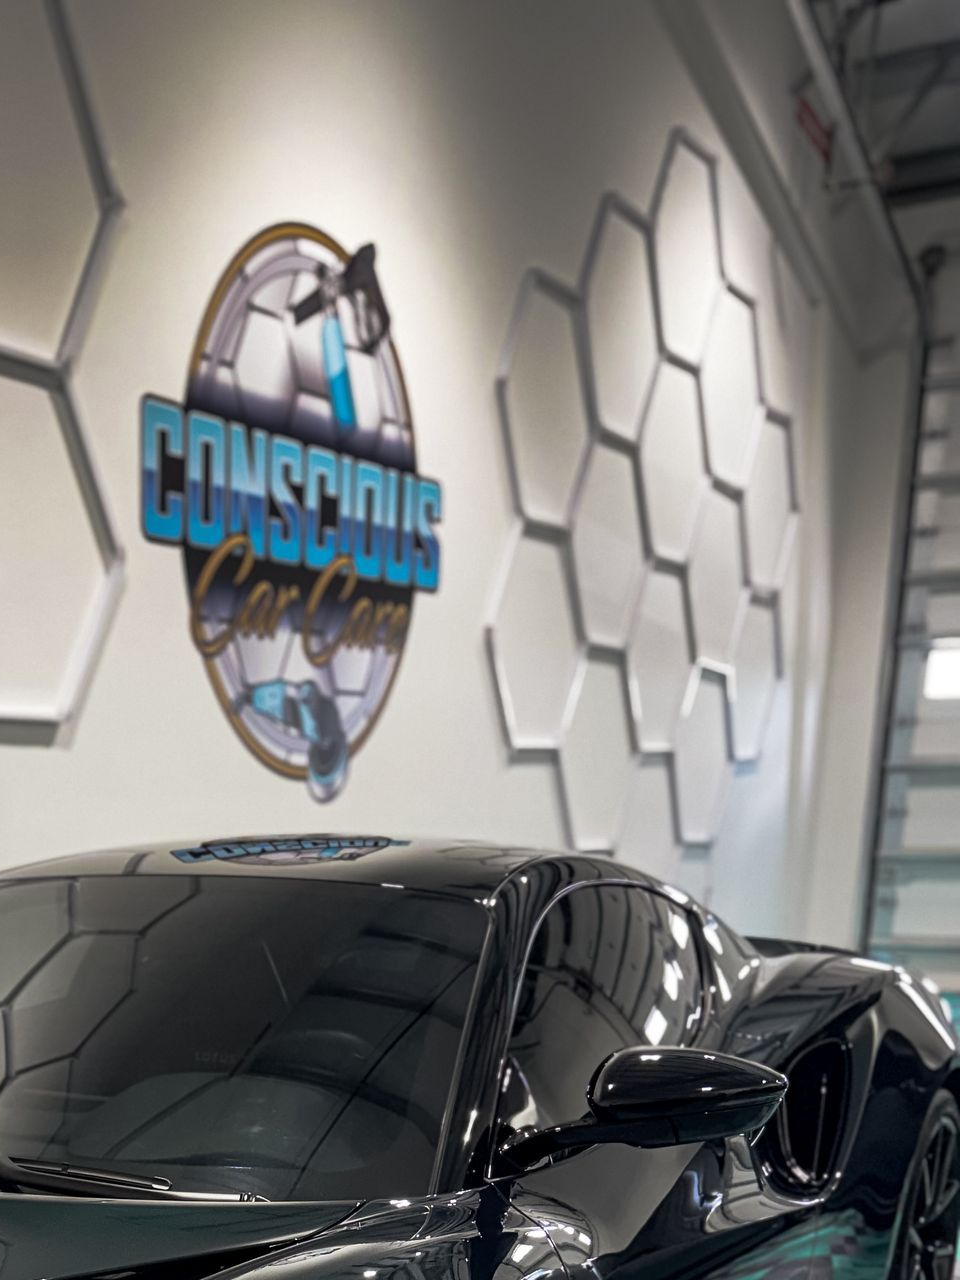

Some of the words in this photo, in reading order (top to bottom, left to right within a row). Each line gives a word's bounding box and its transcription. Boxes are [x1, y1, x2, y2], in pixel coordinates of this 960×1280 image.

[141, 399, 442, 590] CONSCIOUS
[191, 533, 301, 657] Car
[302, 554, 408, 668] Care
